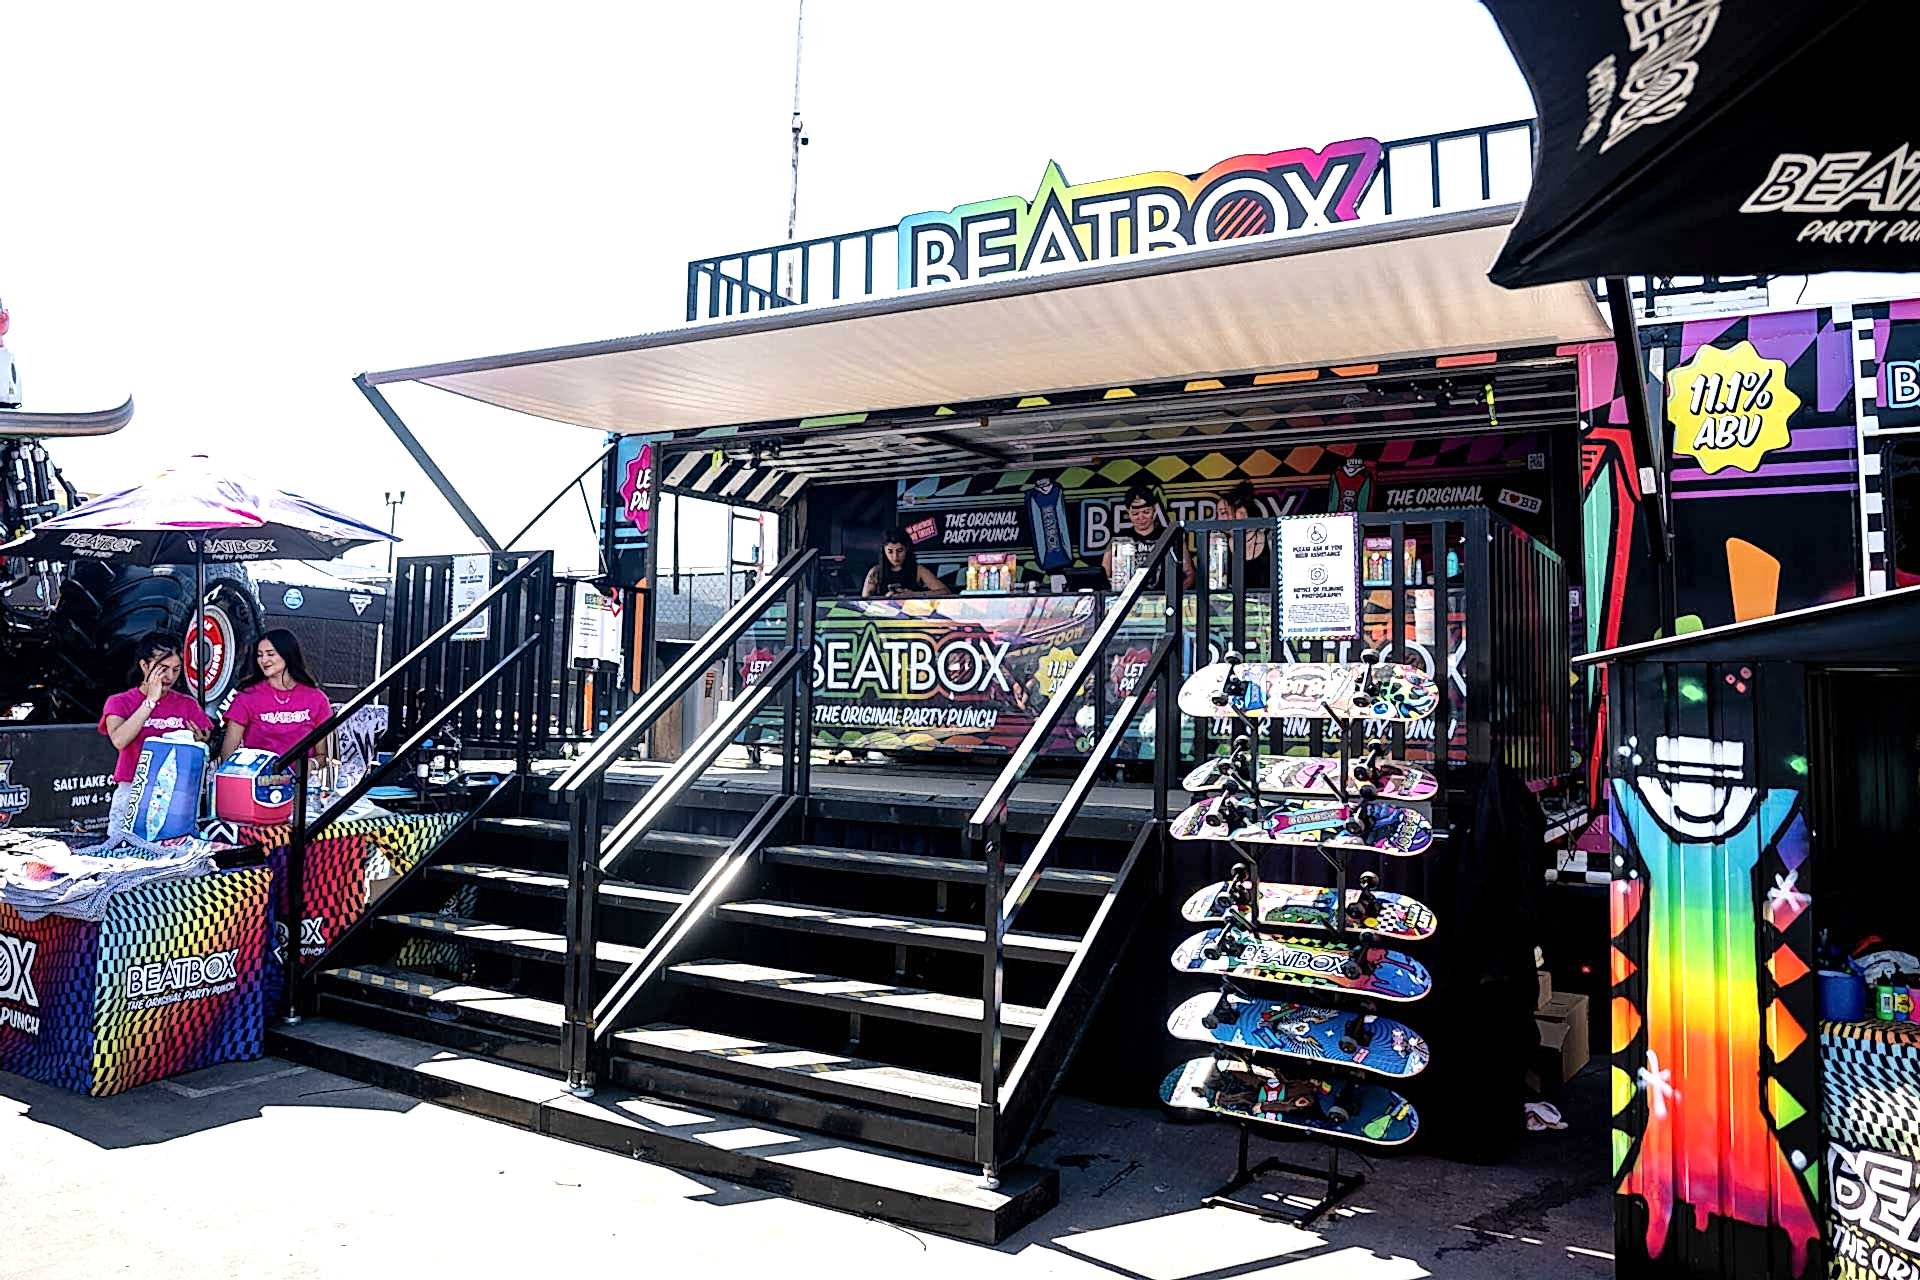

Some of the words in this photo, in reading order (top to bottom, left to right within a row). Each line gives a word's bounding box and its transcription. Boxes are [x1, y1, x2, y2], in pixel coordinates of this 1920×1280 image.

[911, 156, 1362, 288] BEATBOX
[1796, 219, 1888, 244] PARTY
[1883, 219, 1920, 244] PU
[1690, 369, 1774, 416] 11.1%
[636, 468, 652, 490] LE
[1386, 489, 1416, 506] THE
[1416, 484, 1484, 505] ORIGINAL
[943, 513, 967, 528] THE
[966, 510, 1018, 527] ORIGINAL
[187, 539, 278, 553] BATBOX
[943, 528, 980, 544] PARTY
[979, 526, 1020, 543] PUNCH
[812, 640, 1011, 693] BEATBOX
[1123, 663, 1147, 678] LET
[814, 704, 841, 723] THE
[840, 705, 900, 726] ORIGINAL
[901, 706, 947, 728] PARTY
[946, 706, 998, 728] PUNCH
[53, 777, 79, 792] SALT
[80, 774, 107, 787] LAKE
[107, 773, 117, 786] C
[71, 795, 91, 808] JULY
[90, 793, 98, 804] 4
[1240, 944, 1350, 976] BEATBOX
[126, 948, 240, 999] BEATBOX
[126, 999, 146, 1011] THE
[145, 992, 182, 1009] ORIGINAL
[182, 986, 212, 1001] PARTY
[1832, 1223, 1870, 1267] THE
